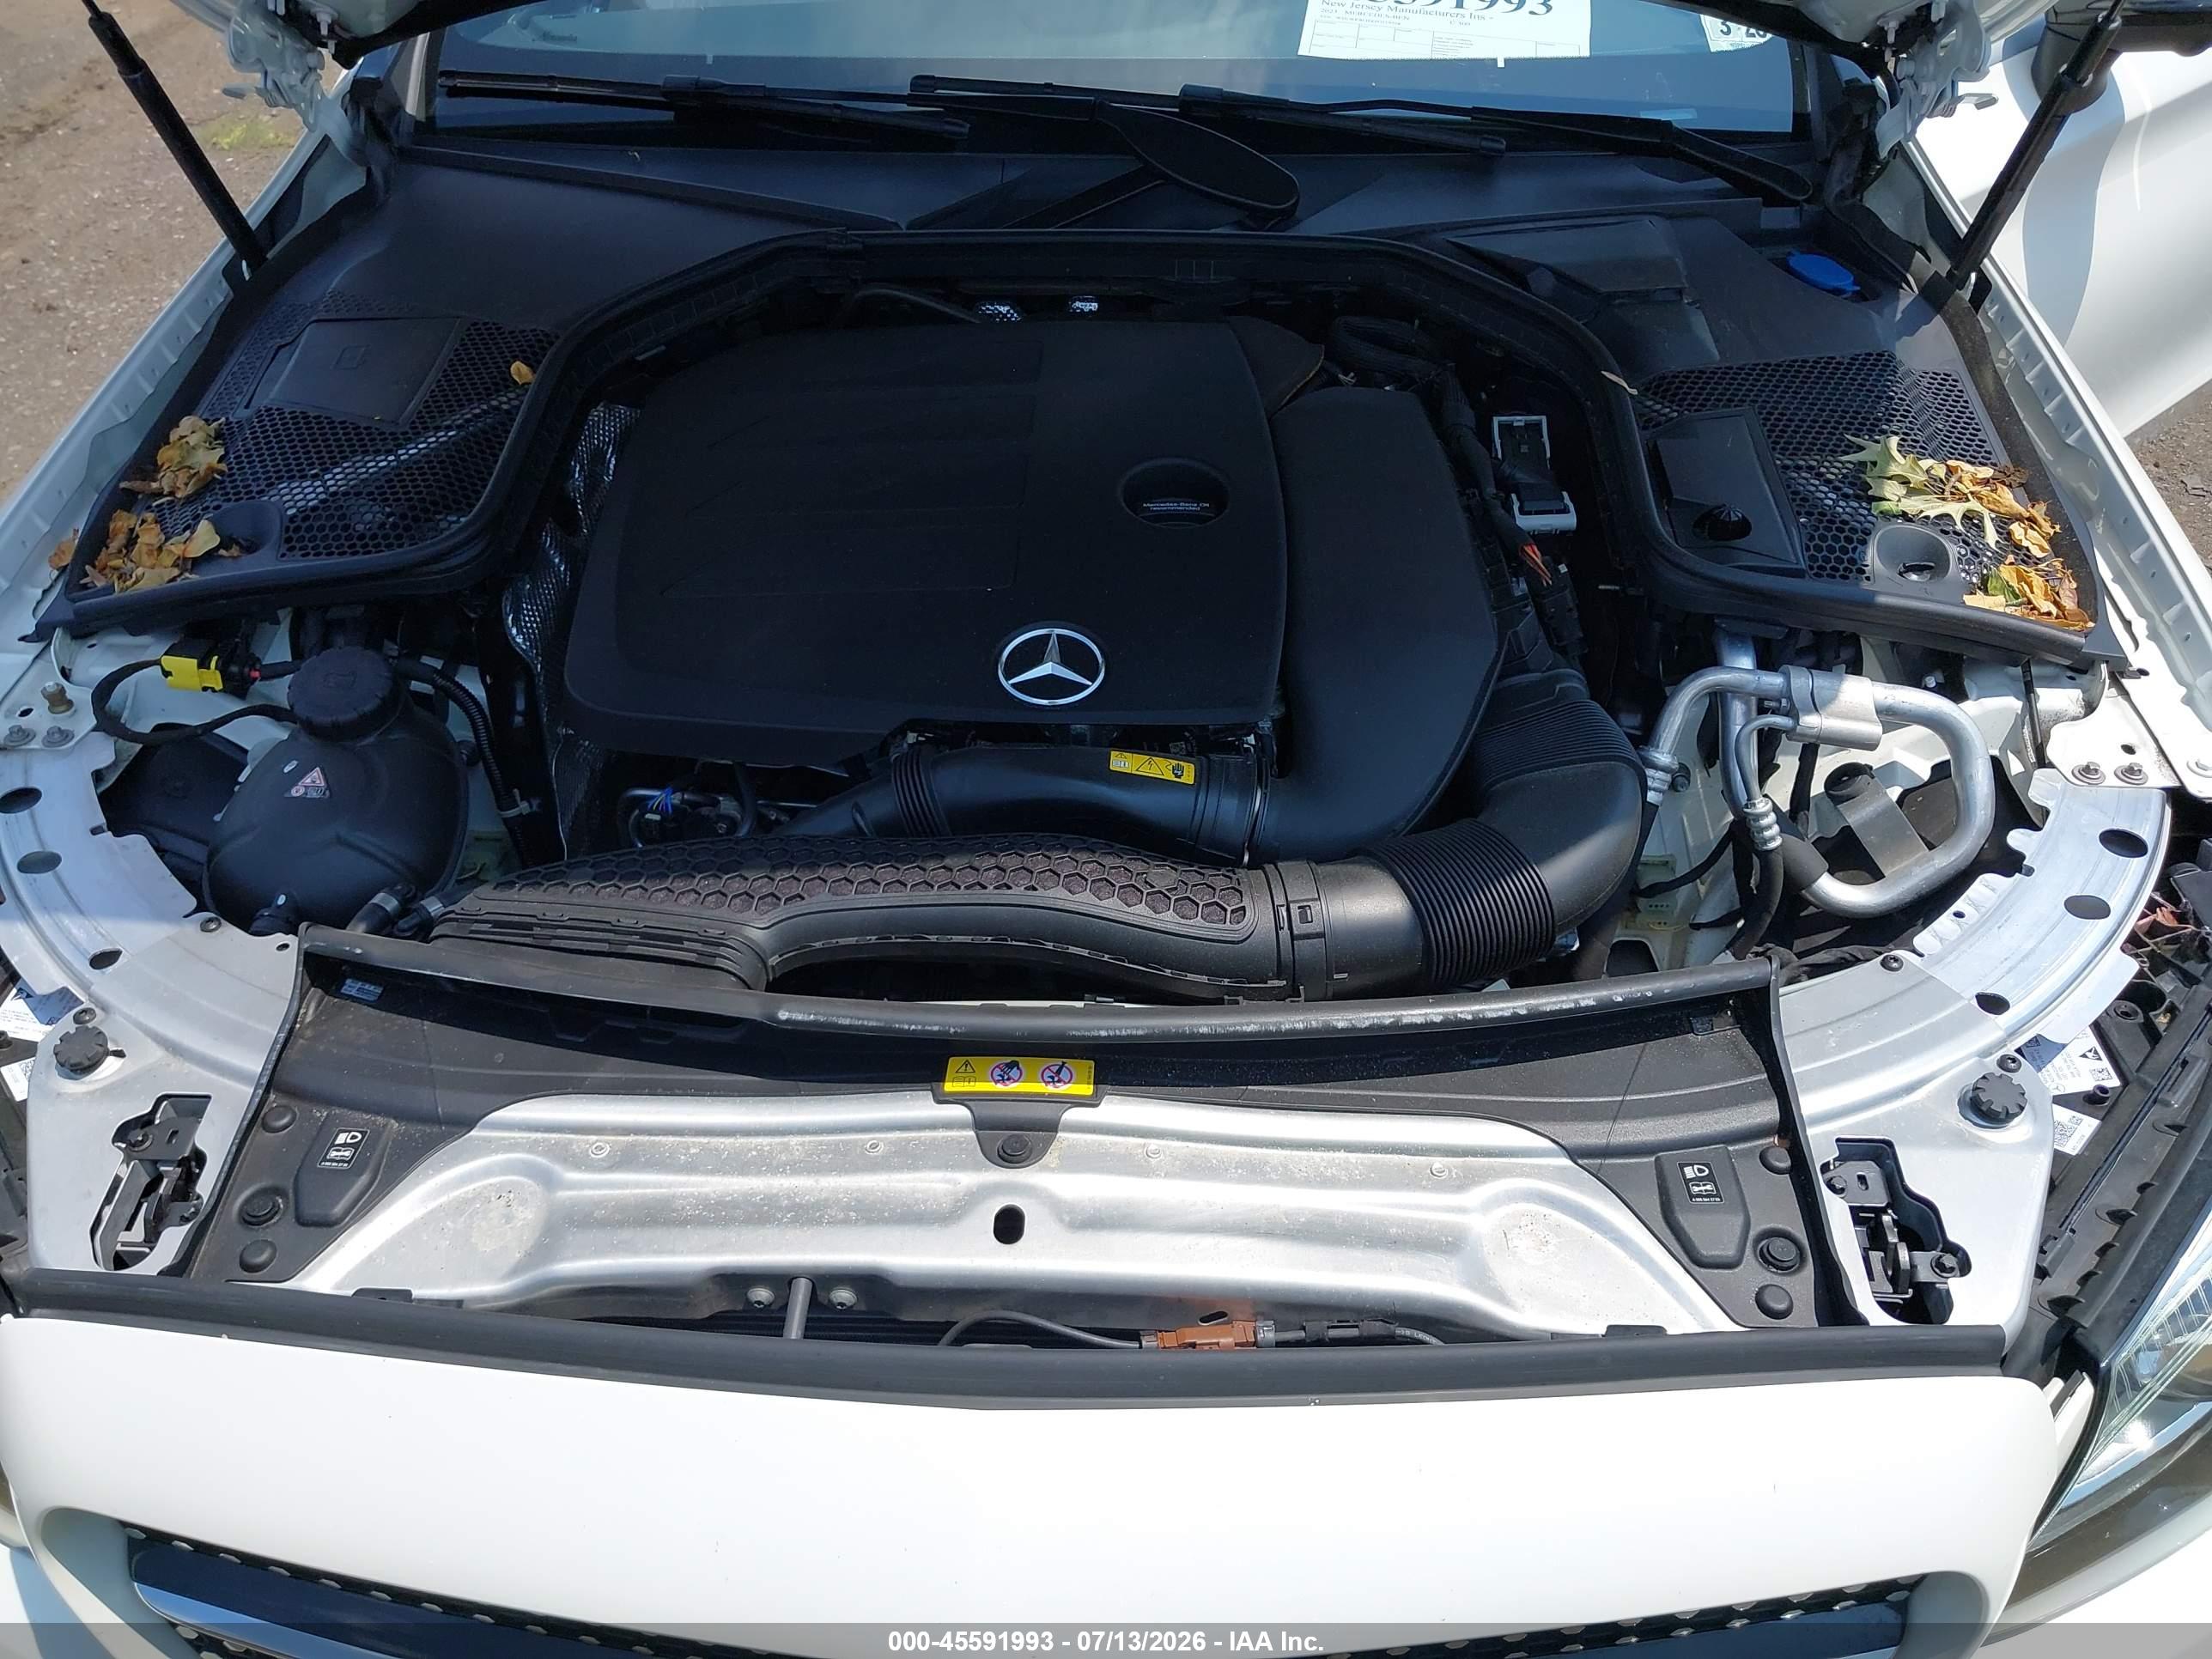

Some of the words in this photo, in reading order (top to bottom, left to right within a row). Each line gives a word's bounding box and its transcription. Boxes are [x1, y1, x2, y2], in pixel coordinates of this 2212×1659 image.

[1349, 2, 1383, 11] Jersey
[1387, 5, 1466, 19] Manufacturers
[1469, 12, 1486, 21] Ins
